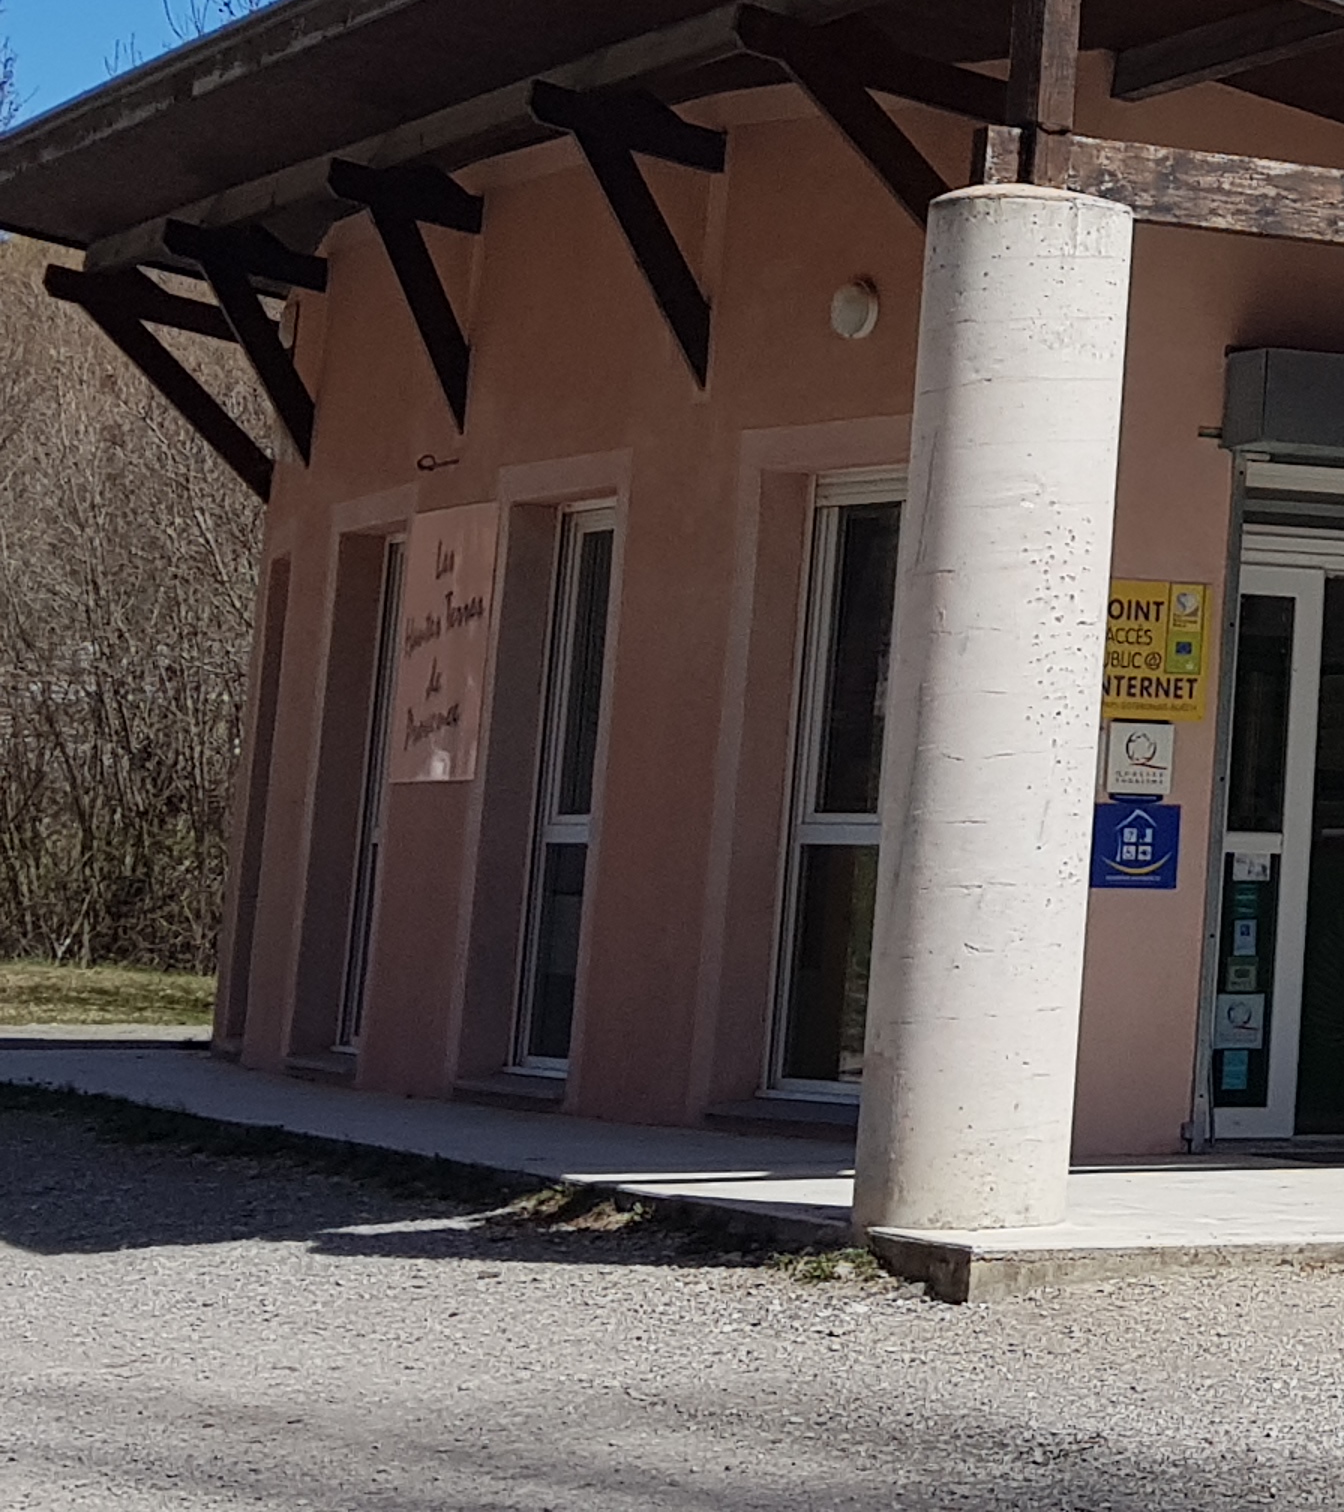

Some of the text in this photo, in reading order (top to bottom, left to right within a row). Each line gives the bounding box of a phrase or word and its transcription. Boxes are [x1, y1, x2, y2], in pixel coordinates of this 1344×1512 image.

[1107, 598, 1165, 622] OINT
[1106, 623, 1153, 646] ACCÈS
[1103, 651, 1143, 669] UBLIC
[1102, 675, 1199, 700] NTERNET
